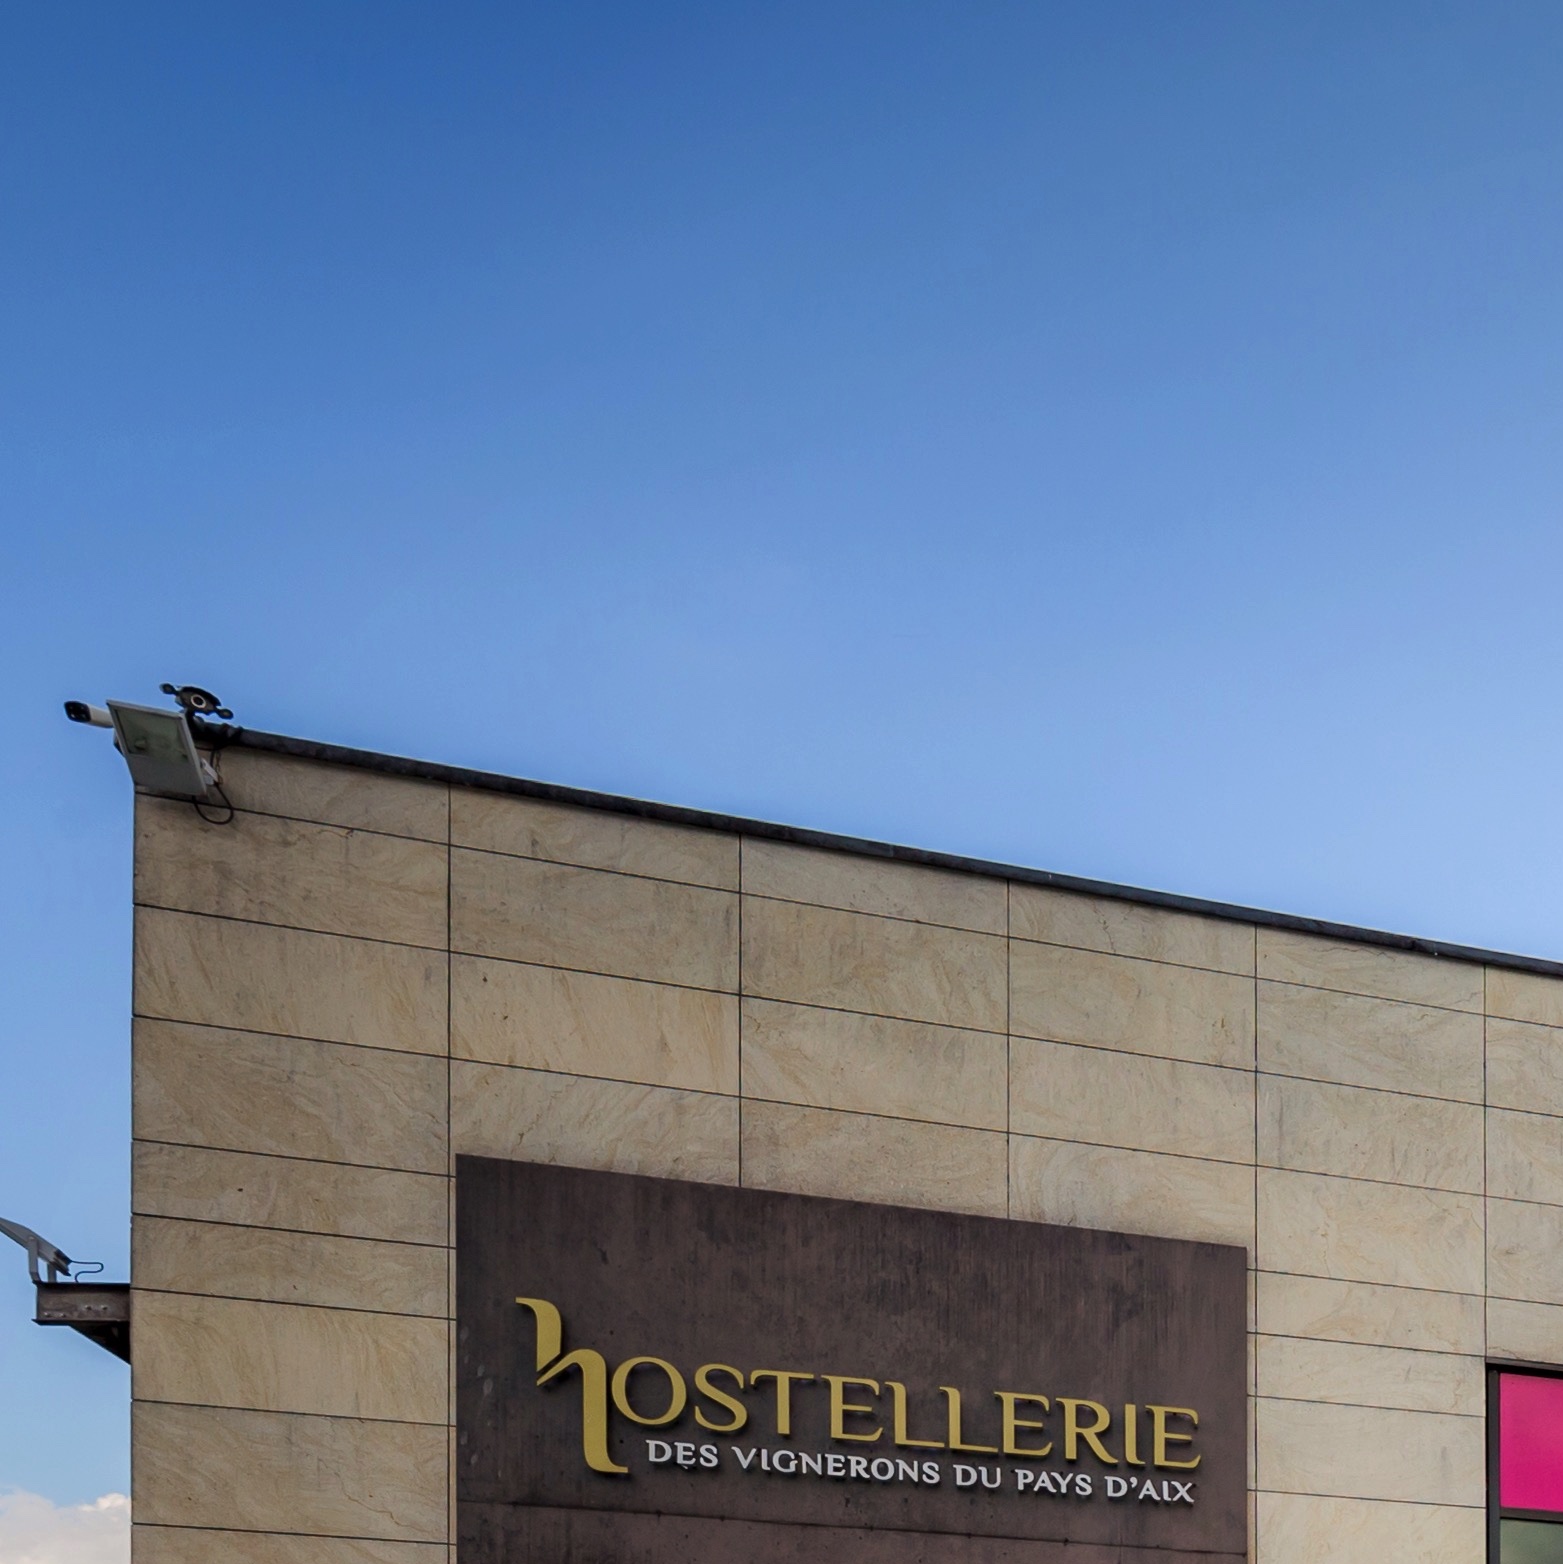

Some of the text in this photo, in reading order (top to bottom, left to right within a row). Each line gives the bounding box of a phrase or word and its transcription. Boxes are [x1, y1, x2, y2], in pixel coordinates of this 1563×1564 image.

[645, 1438, 1196, 1505] DES VIGNERONS DU PAYS D'AIX
